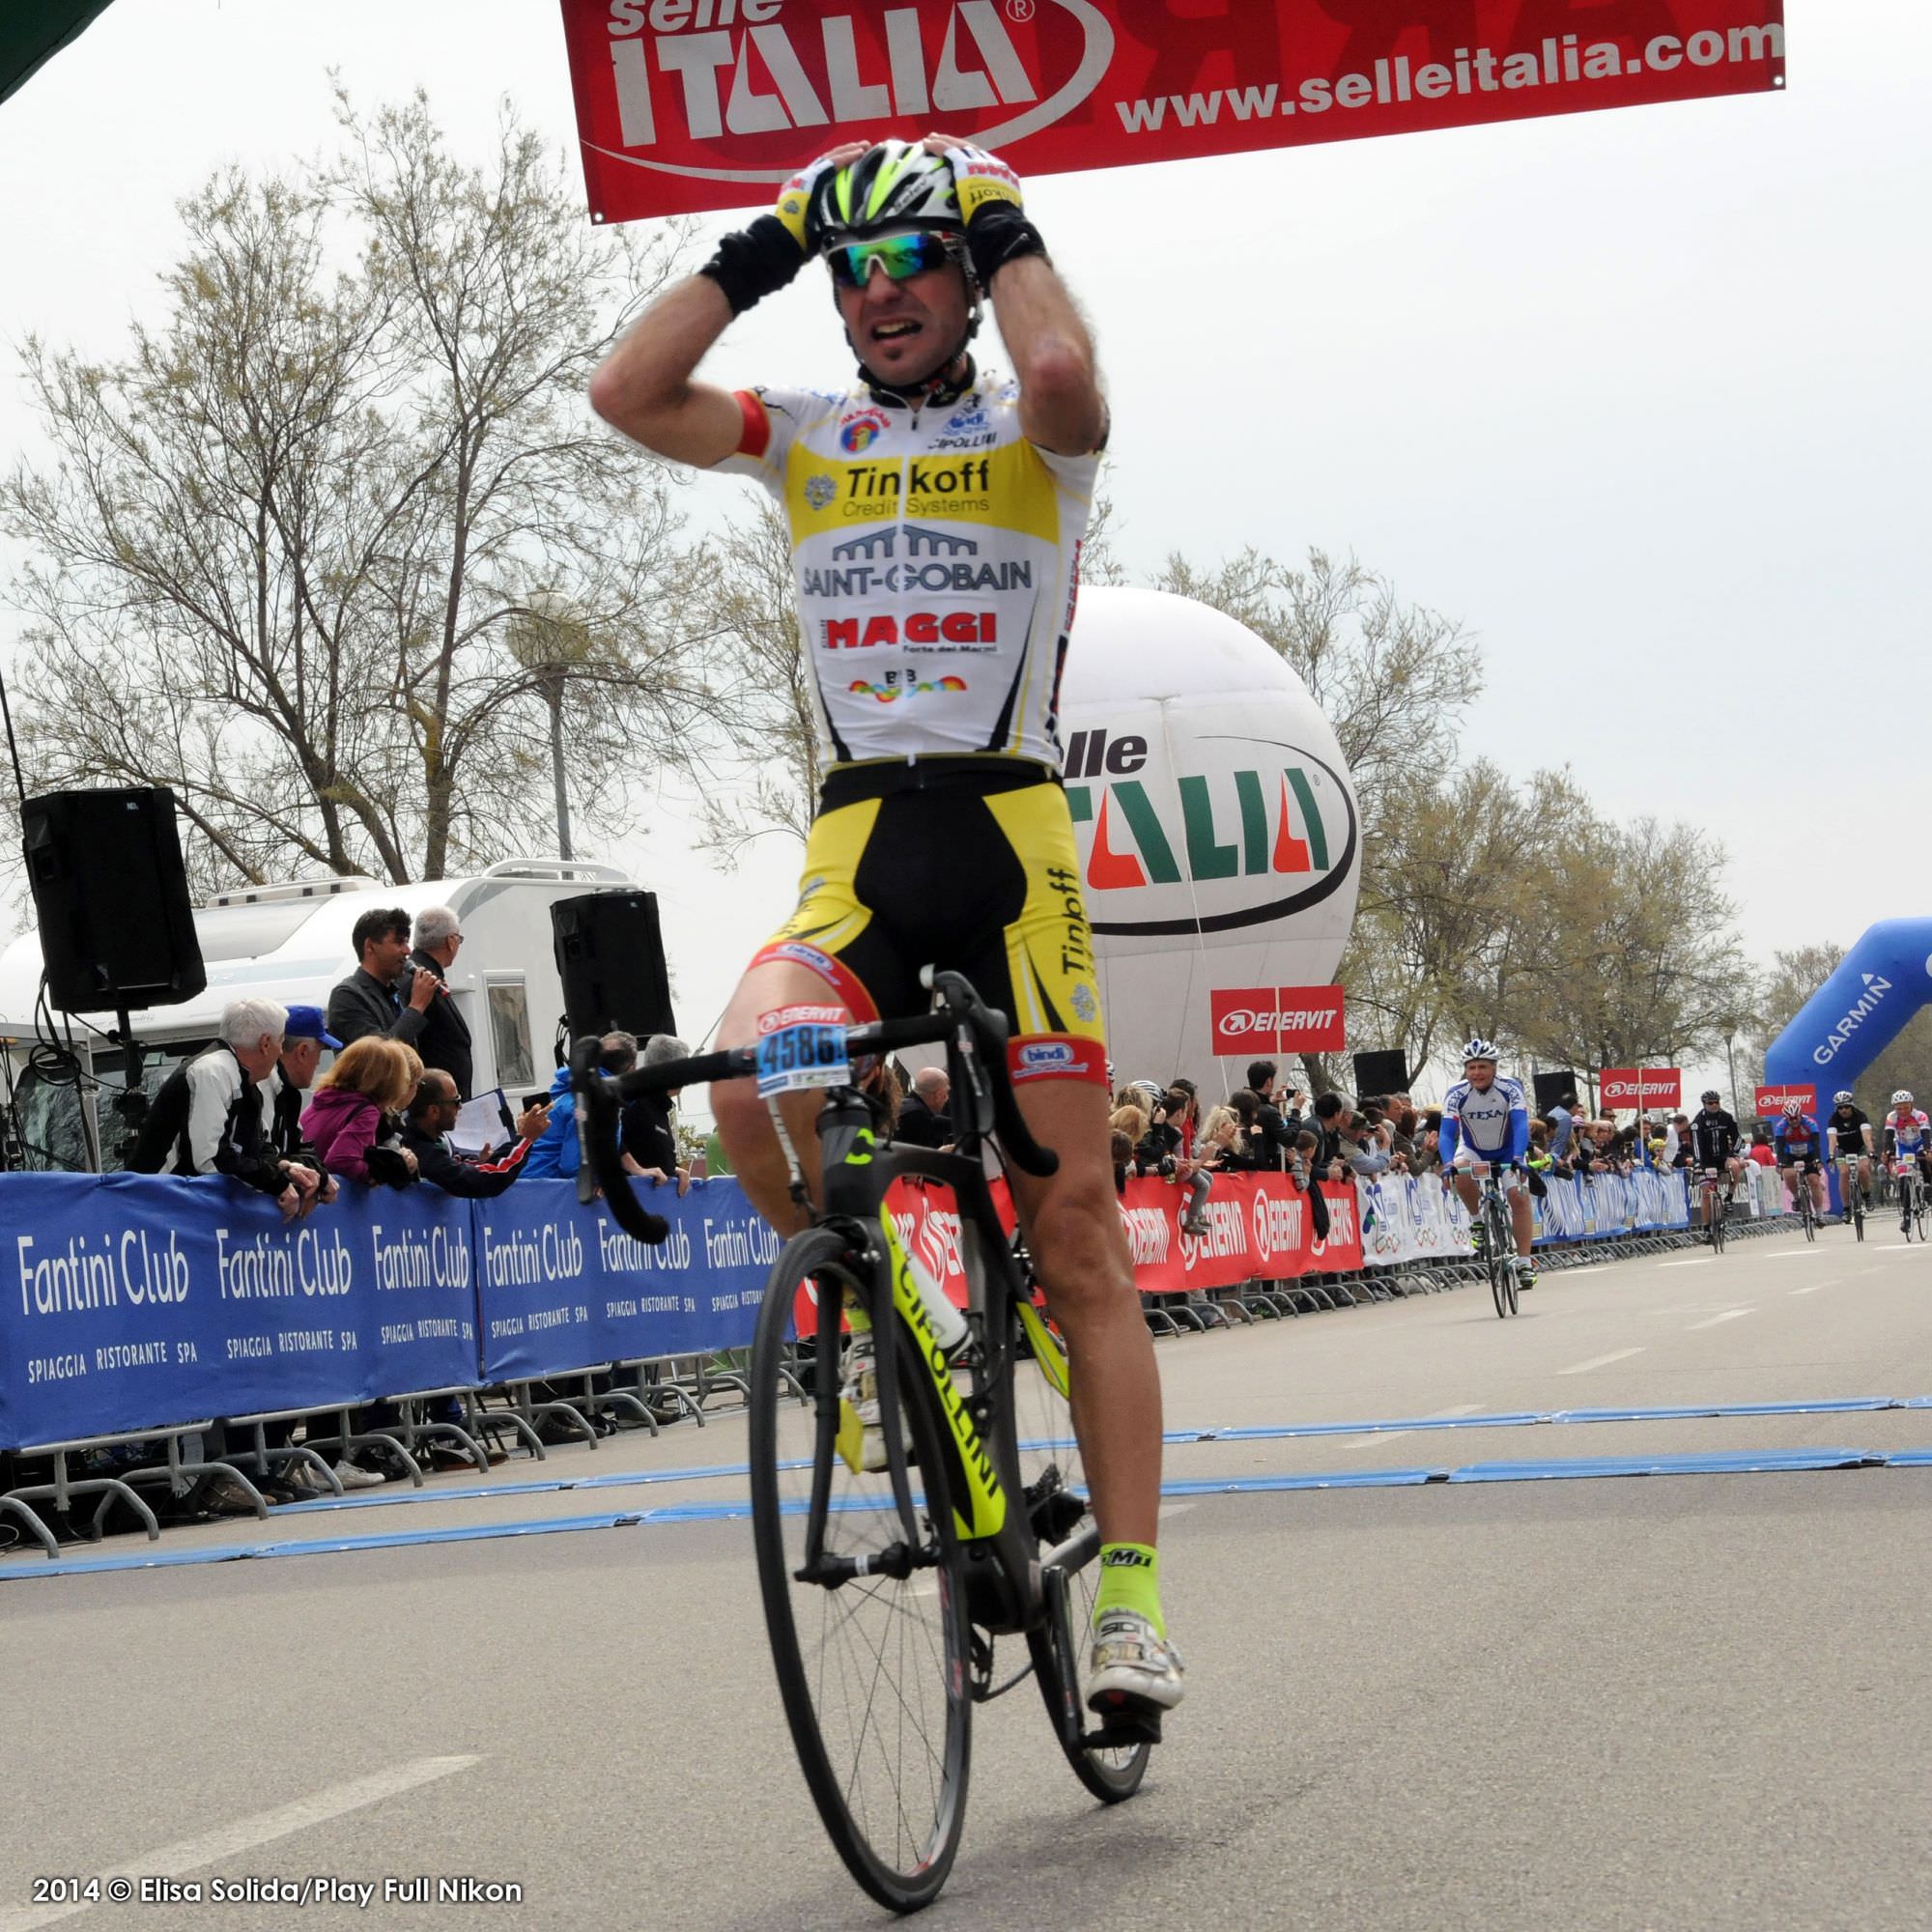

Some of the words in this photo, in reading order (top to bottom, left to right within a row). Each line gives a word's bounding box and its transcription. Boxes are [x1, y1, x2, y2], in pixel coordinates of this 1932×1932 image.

[610, 2, 1037, 147] ITALIA
[1115, 20, 1785, 133] www.selleitalia.com
[847, 460, 989, 497] Tinkoff
[842, 500, 898, 518] Credit
[905, 497, 989, 517] Systems
[827, 612, 997, 649] MAGGI
[1253, 1009, 1337, 1032] ENERVIT
[1812, 976, 1893, 1065] GARMIN
[763, 1026, 835, 1073] 4586
[1028, 1046, 1065, 1062] bindi
[1625, 1082, 1677, 1095] ENERVIT
[1467, 1110, 1503, 1120] TEXA
[372, 1225, 431, 1291] Fantini
[432, 1226, 469, 1289] Club
[484, 1226, 540, 1288] Fantini
[543, 1221, 582, 1284] Club
[704, 1218, 750, 1268] Fantini
[749, 1216, 780, 1265] Club
[17, 1235, 117, 1315] Fantini
[121, 1230, 189, 1305] Club
[216, 1229, 294, 1298] Fantini
[298, 1228, 352, 1296] Club
[607, 1298, 637, 1319] SPIAGGIA
[641, 1295, 679, 1314] RISTORANTE
[684, 1297, 696, 1313] SPA
[712, 1294, 739, 1312] SPIAGGIA
[381, 1326, 413, 1345] SPIAGGIA
[418, 1319, 458, 1339] RISTORANTE
[462, 1322, 473, 1341] SPA
[491, 1317, 525, 1338] SPIAGGIA
[528, 1307, 569, 1330] RISTORANTE
[575, 1306, 588, 1323] SPA
[28, 1353, 86, 1384] SPIAGGIA
[96, 1342, 168, 1370] RISTORANTE
[177, 1342, 198, 1364] SPA
[227, 1336, 272, 1360] SPIAGGIA
[279, 1330, 333, 1352] RISTORANTE
[341, 1330, 357, 1350] SPA
